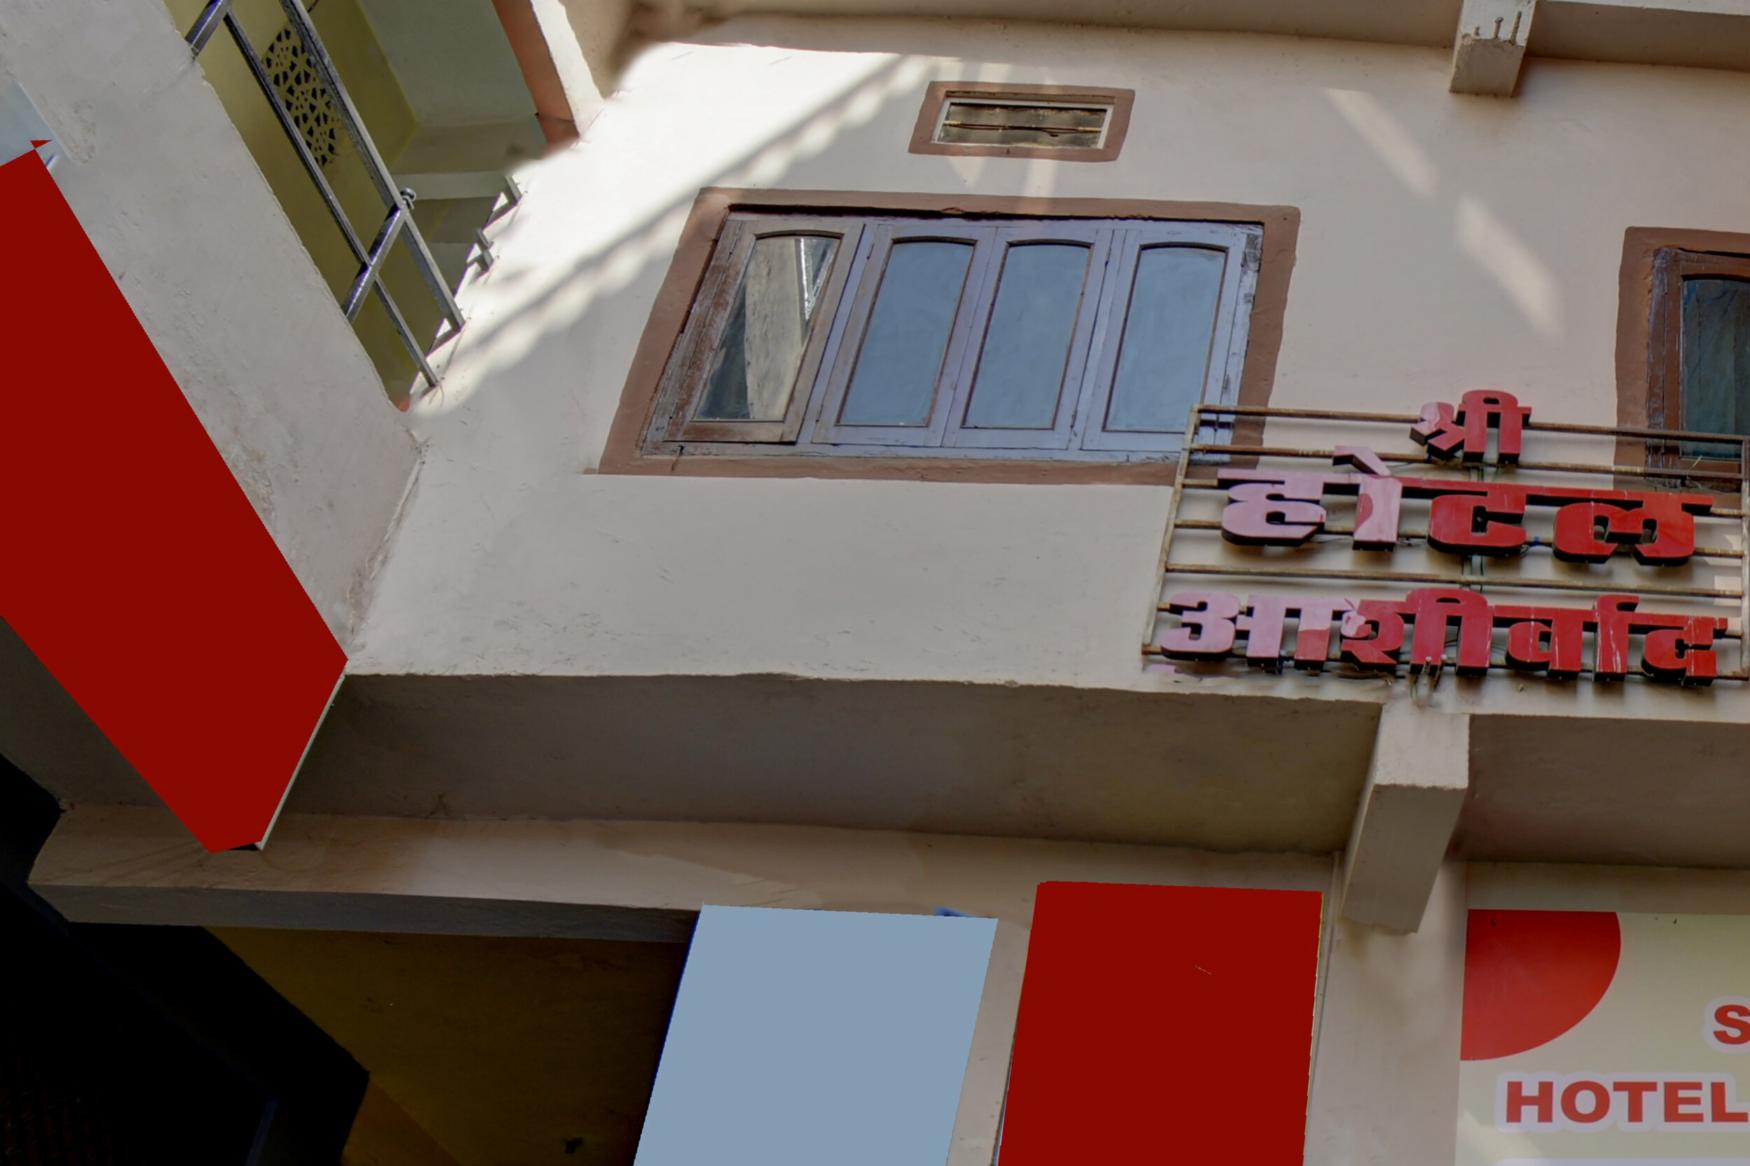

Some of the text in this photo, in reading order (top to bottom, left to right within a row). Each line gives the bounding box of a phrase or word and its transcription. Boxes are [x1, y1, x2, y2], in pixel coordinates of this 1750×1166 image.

[1410, 389, 1532, 464] श्री
[1217, 445, 1714, 566] होटल
[1160, 588, 1728, 685] आशीर्वाद
[1505, 1080, 1748, 1124] HOTEL
